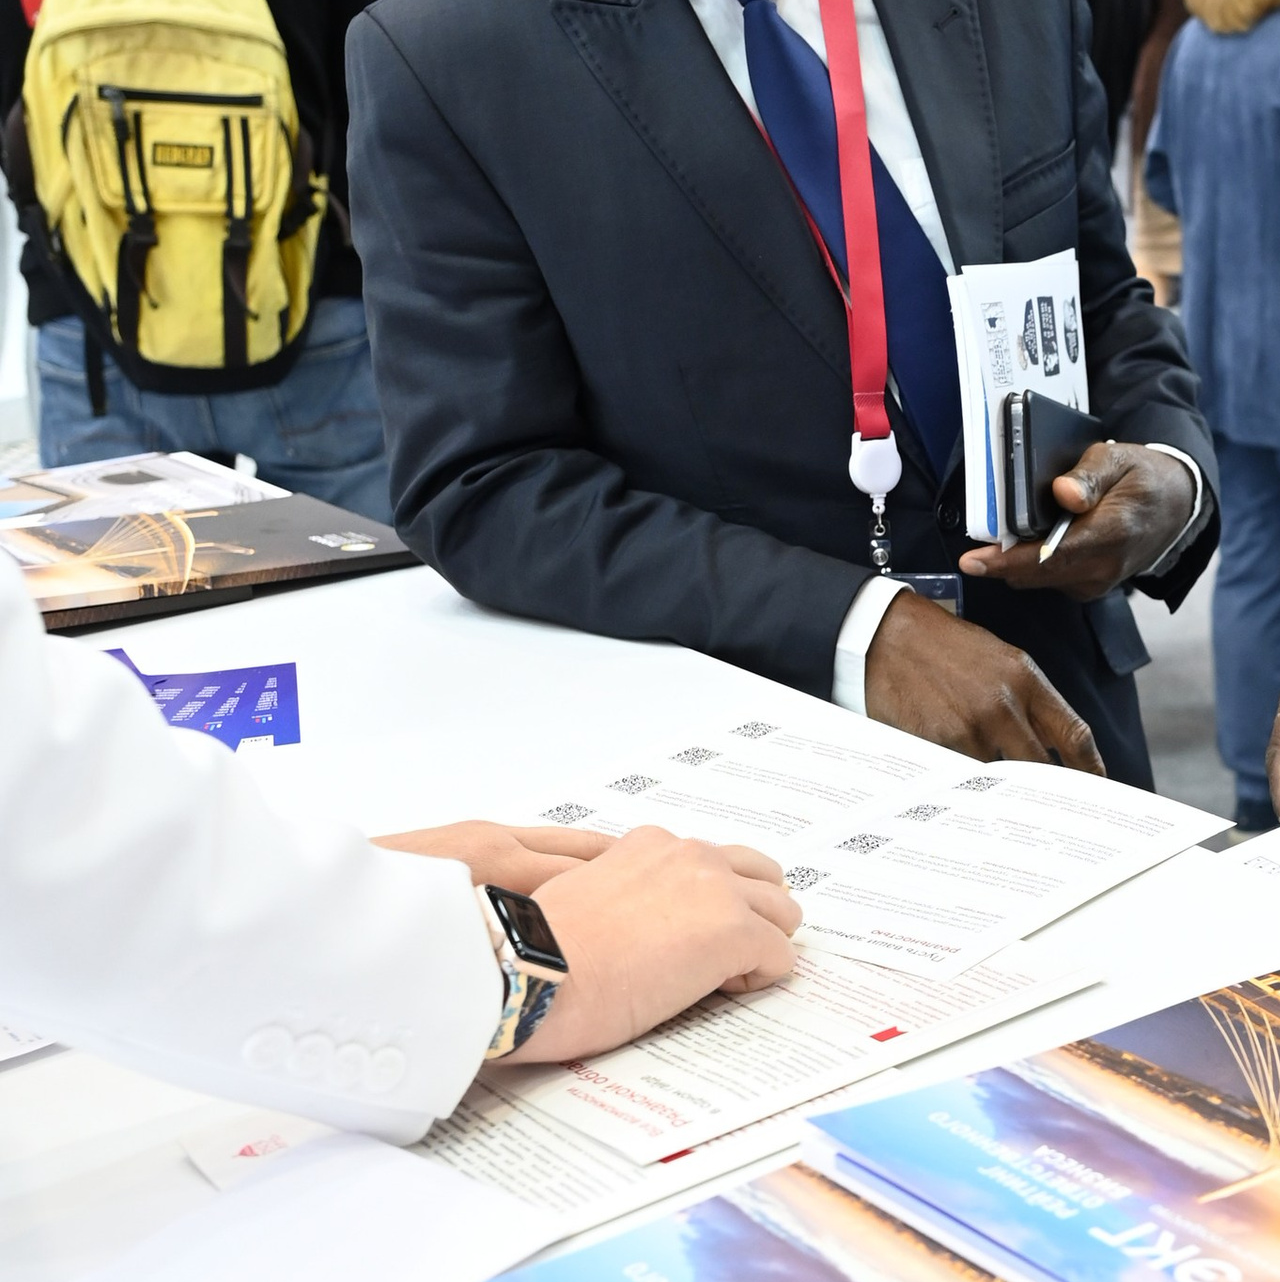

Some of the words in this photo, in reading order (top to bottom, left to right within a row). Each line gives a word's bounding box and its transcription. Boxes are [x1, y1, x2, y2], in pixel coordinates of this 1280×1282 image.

[806, 924, 867, 942] замыслы
[865, 937, 904, 950] ваши
[869, 928, 961, 954] реальностью
[902, 947, 948, 963] Пусть
[598, 1081, 695, 1129] Рязанской
[1029, 1143, 1133, 1200] БИЗНЕСА
[972, 1163, 1081, 1220] РЕЙТИНГ
